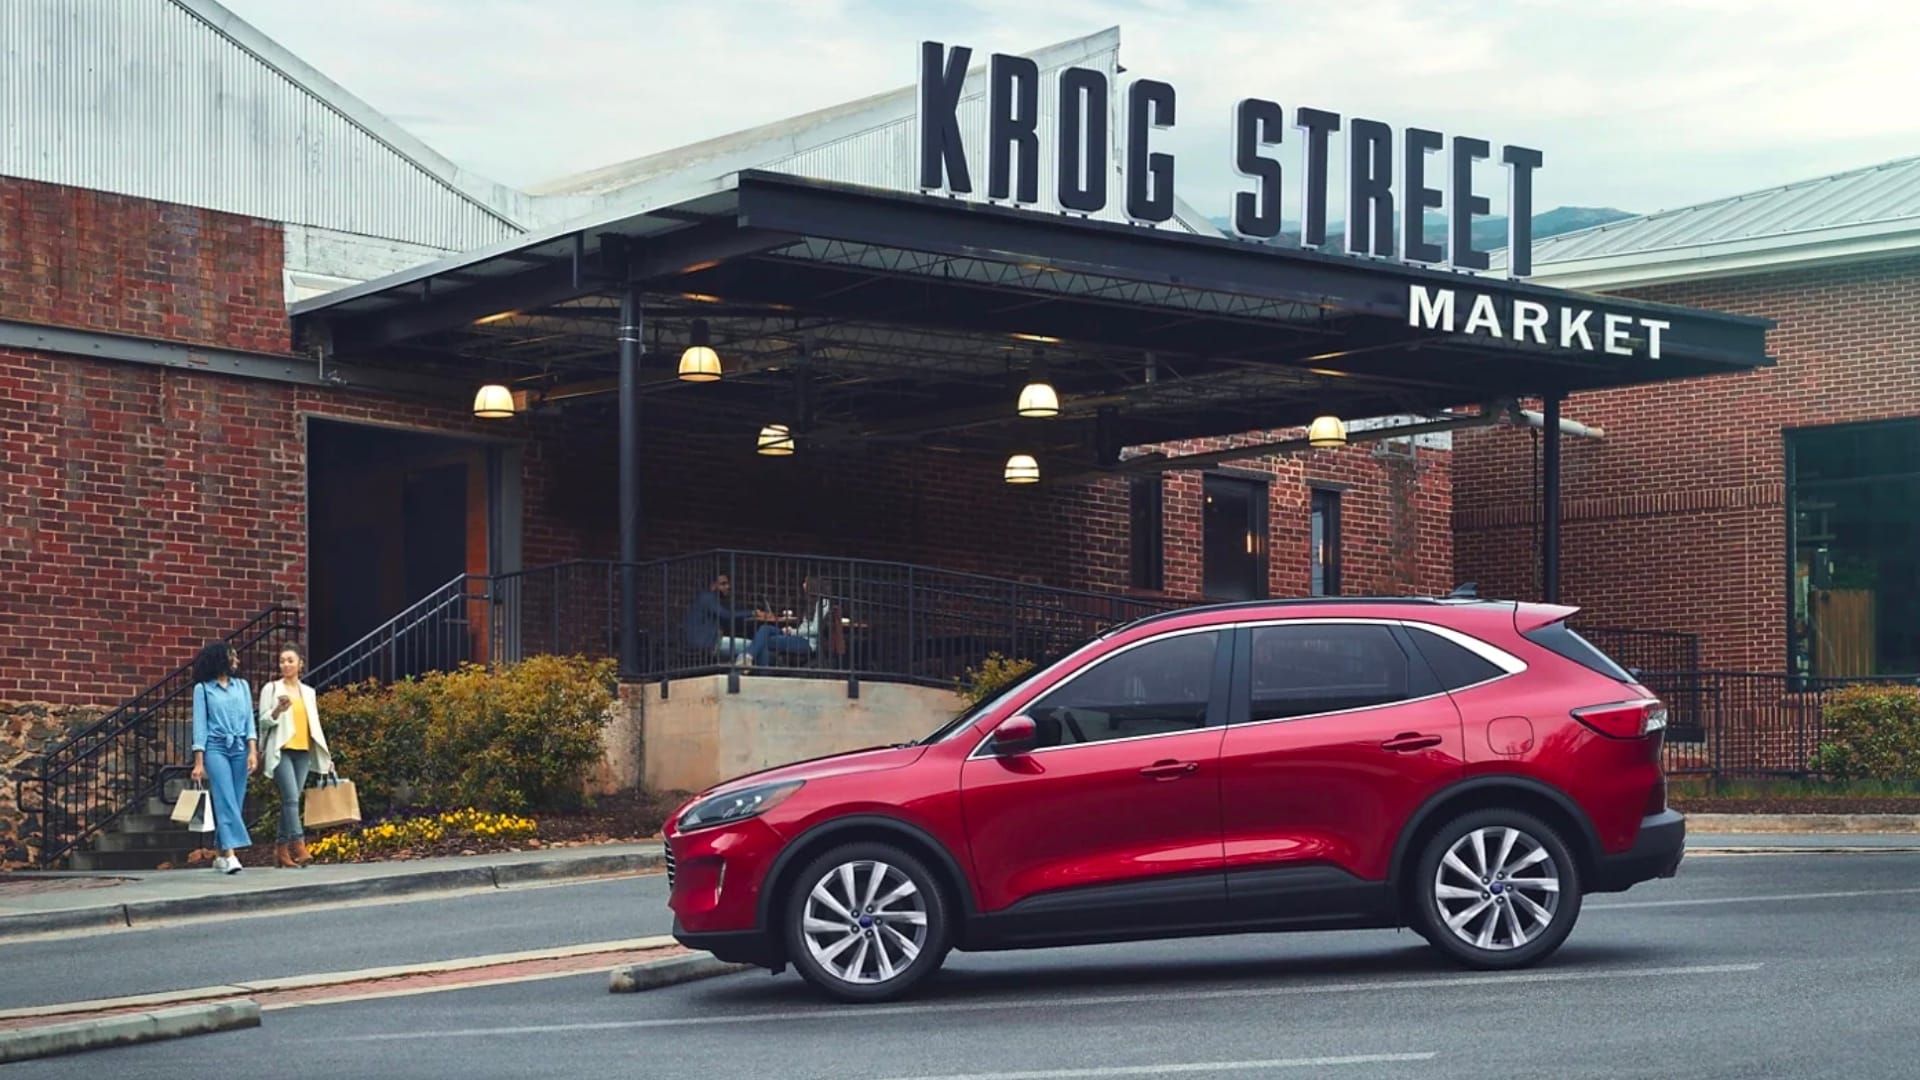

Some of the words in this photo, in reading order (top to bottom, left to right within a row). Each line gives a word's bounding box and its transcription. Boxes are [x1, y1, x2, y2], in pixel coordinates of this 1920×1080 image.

[919, 40, 1176, 224] KROG
[1232, 97, 1543, 278] STREET
[1409, 284, 1670, 360] MARKET
